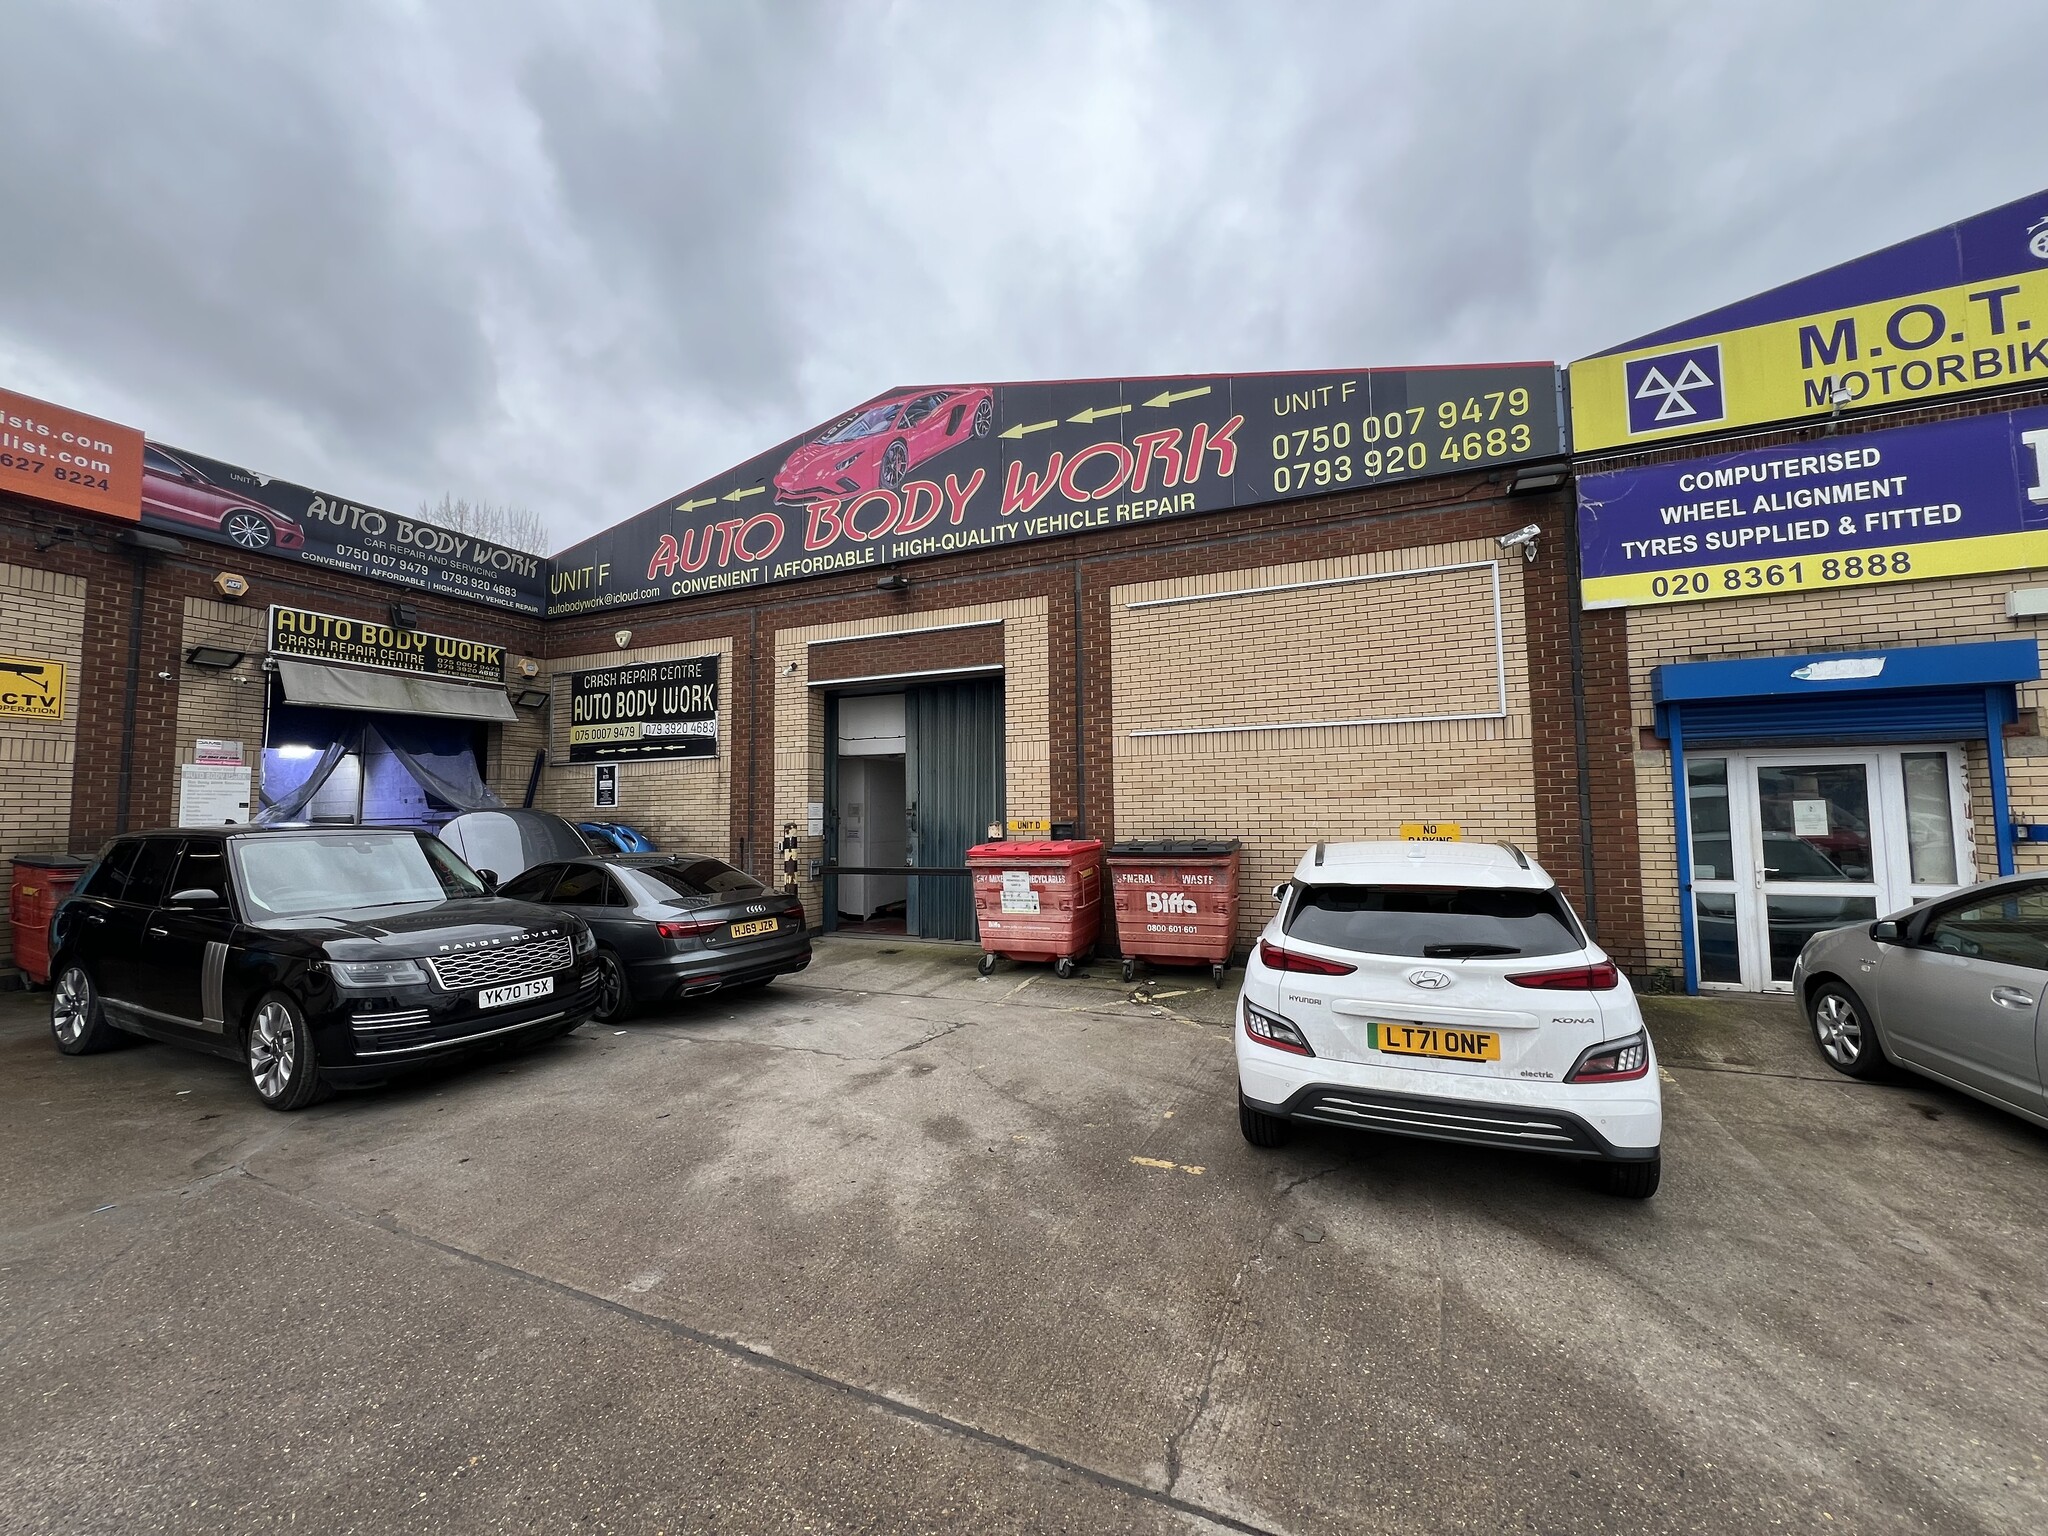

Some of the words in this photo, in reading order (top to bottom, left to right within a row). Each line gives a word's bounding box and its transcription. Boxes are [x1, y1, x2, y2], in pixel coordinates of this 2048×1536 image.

[1798, 285, 2031, 369] M.O.T.
[1274, 385, 1333, 416] UNIT
[1342, 380, 1357, 402] F
[0, 410, 113, 454] ists.com
[1272, 422, 1350, 460] 0750
[1362, 406, 1425, 443] 007
[1437, 387, 1529, 429] 9479
[3, 433, 110, 473] list.com
[1273, 455, 1352, 493] 0793
[1364, 441, 1427, 477] 920
[1440, 424, 1531, 463] 4683
[1679, 447, 1881, 492] COMPUTERISED
[0, 453, 45, 473] 627
[54, 467, 110, 491] 8224
[230, 473, 250, 484] UNIT
[646, 512, 785, 580] AUTO
[804, 468, 986, 551] BODY
[1000, 414, 1245, 516] WORK
[1660, 498, 1747, 525] WHEEL
[1752, 476, 1907, 514] ALIGNMENT
[306, 495, 387, 535] AUTO
[397, 519, 469, 558] BODY
[473, 543, 538, 579] WORK
[671, 567, 760, 596] CONVENIENT
[773, 547, 875, 579] AFFORDABLE
[892, 521, 1018, 559] HIGH-QUALITY
[1024, 507, 1109, 536] VEHICLE
[1116, 492, 1196, 522] REPAIR
[1621, 534, 1698, 560] TYRES
[1705, 519, 1830, 550] SUPPLIED
[1838, 516, 1857, 535] &
[1864, 503, 1962, 533] FITTED
[336, 544, 370, 561] 0750
[372, 552, 395, 569] 007
[399, 559, 429, 576] 9479
[441, 570, 468, 587] 0793
[471, 577, 490, 591] 920
[492, 583, 517, 598] 4683
[364, 537, 386, 550] CAR
[389, 542, 426, 561] REPAIR
[428, 554, 448, 566] AND
[450, 559, 498, 579] SERVICING
[1652, 572, 1709, 597] 020
[1723, 562, 1803, 590] 8361
[1821, 551, 1911, 581] 8888
[226, 580, 242, 589] ADT
[301, 552, 363, 572] CONVENIENT
[371, 568, 425, 587] AFFORDABLE
[433, 583, 484, 602] HIGH-QUALITY
[486, 595, 514, 608] VEHICLE
[515, 602, 538, 614] REPAIR
[551, 566, 593, 595] UNIT
[599, 563, 611, 586] F
[547, 587, 660, 616] autobodywork@icloud.com
[277, 609, 351, 640] AUTO
[362, 624, 427, 653] BODY
[435, 638, 499, 665] WORK
[278, 633, 325, 650] CRASH
[332, 641, 376, 658] REPAIR
[380, 649, 425, 665] CENTRE
[584, 672, 617, 689] CRASH
[619, 668, 657, 685] REPAIR
[660, 663, 702, 680] CENTRE
[0, 705, 56, 714] PERATION
[574, 693, 611, 722] AUTO
[616, 688, 658, 718] BODY
[662, 683, 715, 714] WORK
[574, 729, 590, 741] 075
[591, 727, 612, 739] 0007
[613, 726, 635, 738] 9479
[645, 724, 662, 735] 079
[664, 722, 688, 734] 3920
[690, 721, 715, 733] 4683
[1017, 821, 1033, 829] UNIT
[1035, 821, 1041, 829] D
[1423, 825, 1437, 834] NO
[1145, 891, 1197, 914] Biffa
[439, 939, 500, 951] RANGE
[510, 929, 559, 941] ROVER
[734, 923, 757, 936] HJ69
[758, 920, 774, 931] JZR
[485, 985, 521, 1004] YK70
[525, 979, 549, 995] TSX
[1288, 995, 1322, 1006] HYUNDAI
[1386, 1027, 1438, 1051] LT71
[1444, 1032, 1491, 1055] ONF
[1520, 1070, 1554, 1079] electric
